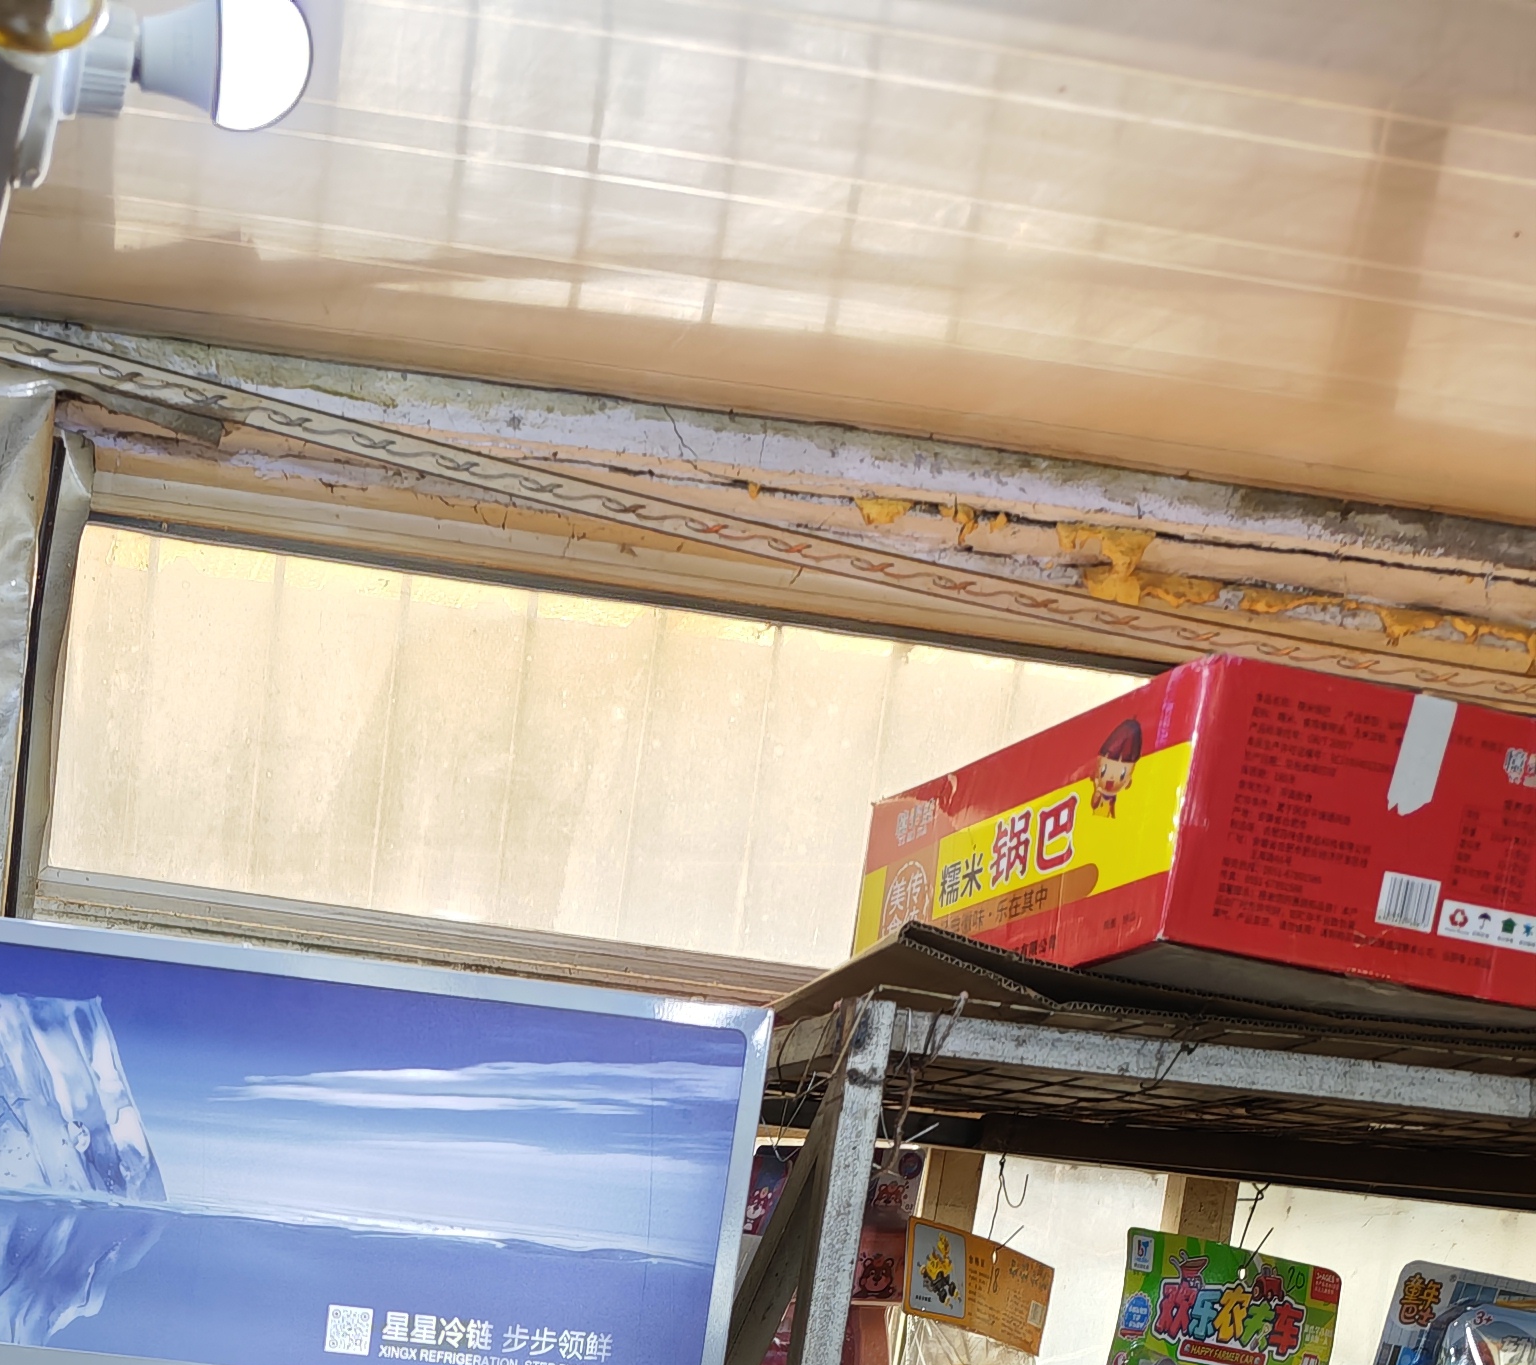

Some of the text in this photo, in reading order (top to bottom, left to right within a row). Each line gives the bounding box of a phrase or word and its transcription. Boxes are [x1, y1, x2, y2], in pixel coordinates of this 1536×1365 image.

[938, 852, 983, 908] 糯米
[989, 794, 1078, 889] 锅巴
[378, 1344, 418, 1361] XINGX
[381, 1310, 614, 1363] 星星冷链 步步领鲜
[1190, 1344, 1213, 1358] HAPPY
[1239, 1353, 1255, 1365] CAR
